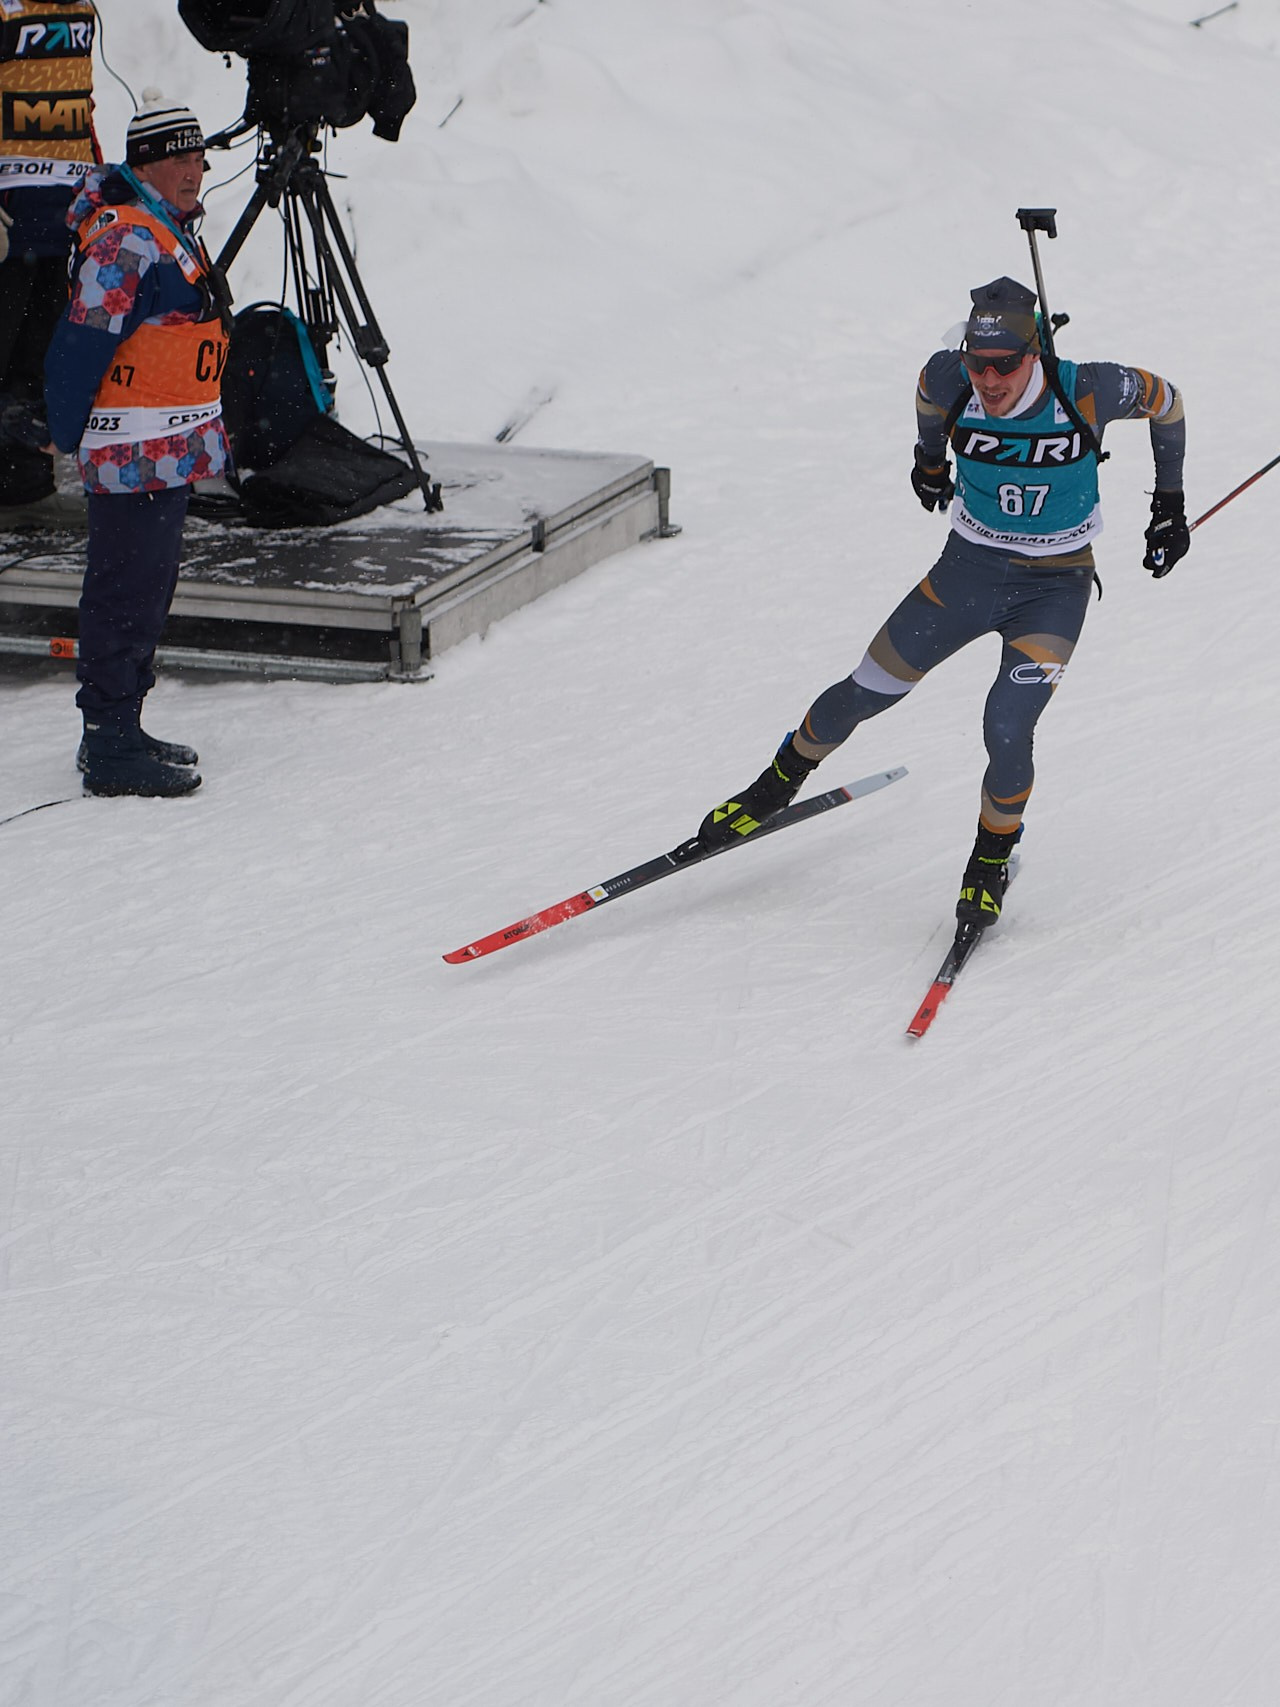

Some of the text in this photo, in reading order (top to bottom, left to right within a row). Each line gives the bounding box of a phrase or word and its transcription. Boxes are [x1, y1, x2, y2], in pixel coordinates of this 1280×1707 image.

[15, 21, 92, 55] PARI
[166, 136, 206, 153] RUSS
[66, 162, 93, 175] 202
[110, 365, 135, 387] 47
[964, 432, 1081, 463] PARI
[998, 483, 1051, 516] 67
